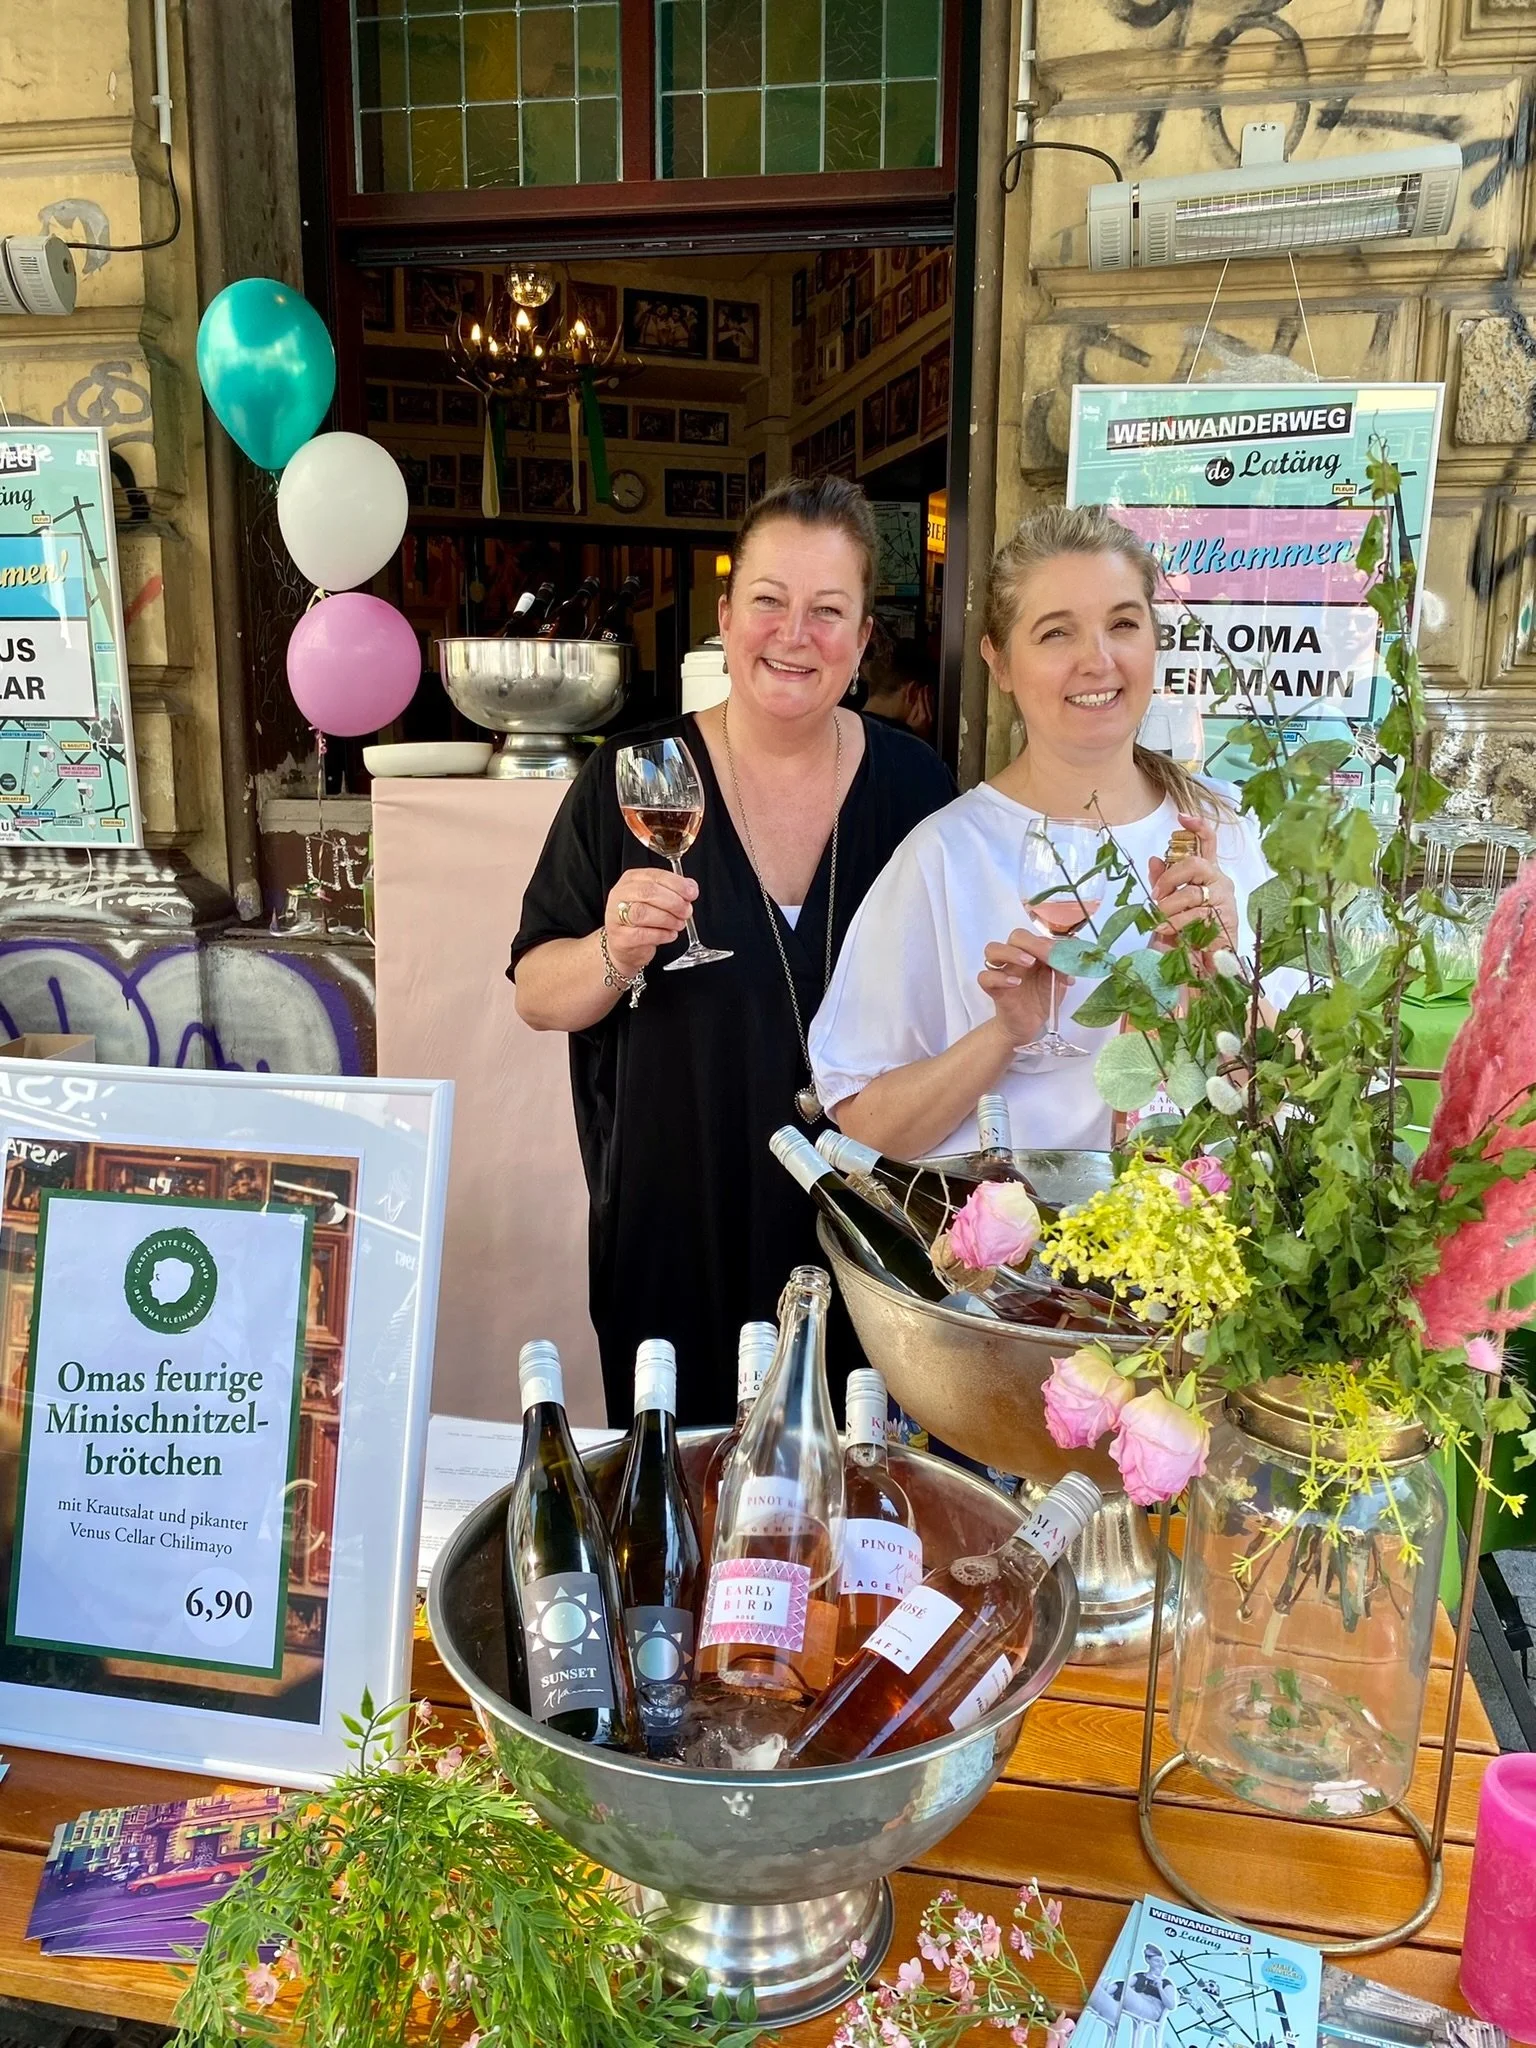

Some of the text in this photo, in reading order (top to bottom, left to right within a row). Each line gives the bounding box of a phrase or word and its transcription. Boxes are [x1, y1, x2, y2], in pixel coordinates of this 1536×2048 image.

[1113, 407, 1347, 444] WEINWANDERWEG
[1207, 449, 1342, 481] de Latäng
[1227, 624, 1322, 654] OMA
[181, 1242, 199, 1256] SEIT
[143, 1305, 159, 1320] OMA
[163, 1294, 207, 1323] KLEINMANN
[57, 1358, 264, 1402] Omas feurige
[45, 1402, 269, 1434] Minischnitzel-
[85, 1442, 223, 1477] brötchen
[57, 1498, 249, 1532] mit Krautsalat und pikanter
[69, 1521, 233, 1557] Venus Cellar Chilimayo
[860, 1538, 905, 1556] PINOT
[724, 1585, 776, 1597] EARLY
[843, 1579, 905, 1595] LAGEN
[184, 1585, 253, 1622] 6,90
[723, 1599, 774, 1612] BIRD
[540, 1667, 597, 1689] SUNSET
[1151, 1908, 1250, 1943] WEINWANDERWEG
[1178, 1930, 1222, 1951] Latäng
